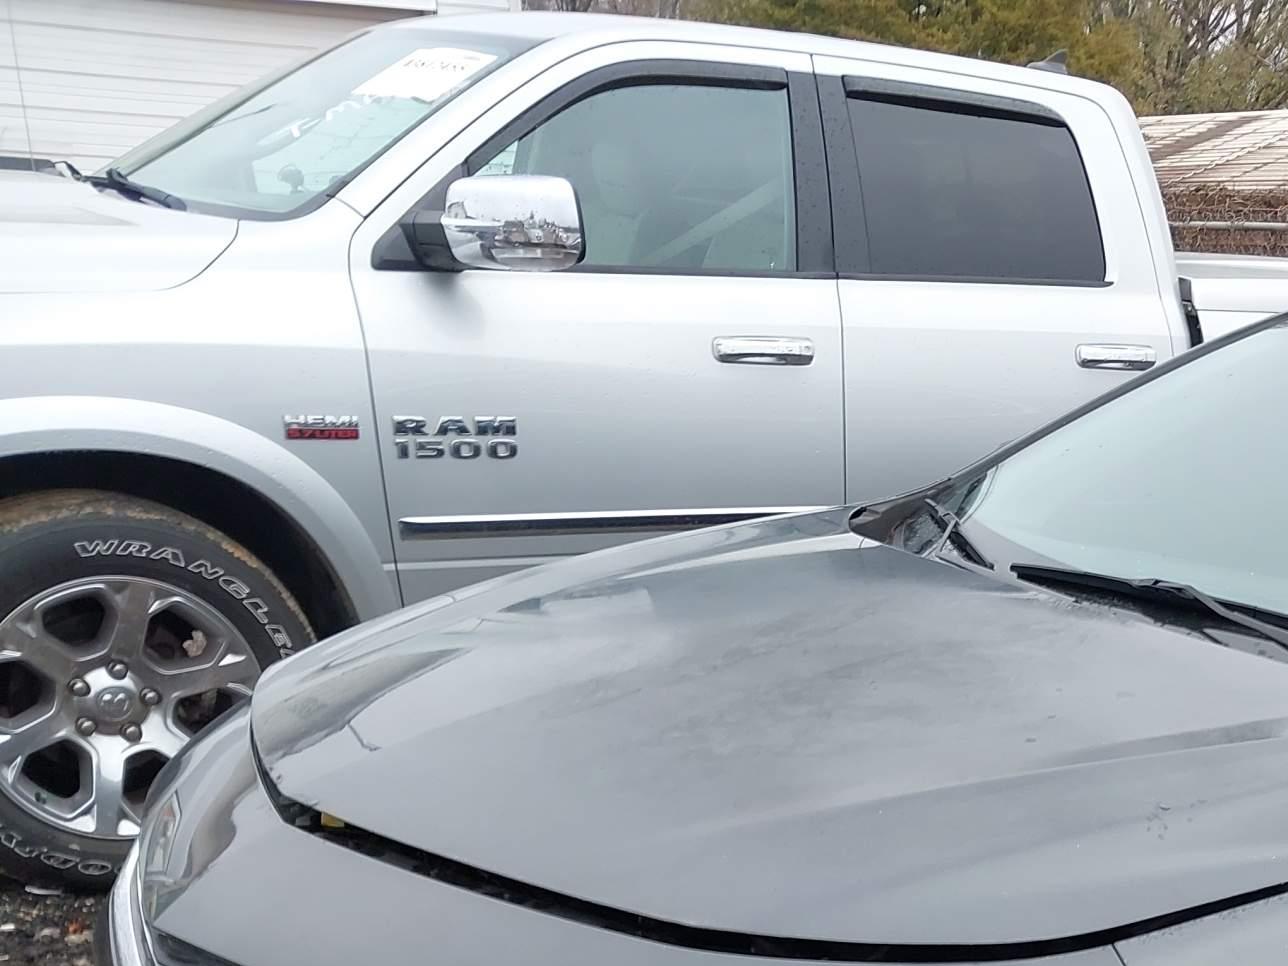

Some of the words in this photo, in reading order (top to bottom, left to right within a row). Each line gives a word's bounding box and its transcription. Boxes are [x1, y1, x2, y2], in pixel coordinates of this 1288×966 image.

[284, 415, 359, 427] HEMI
[392, 415, 517, 436] RAM
[395, 439, 518, 459] 1500
